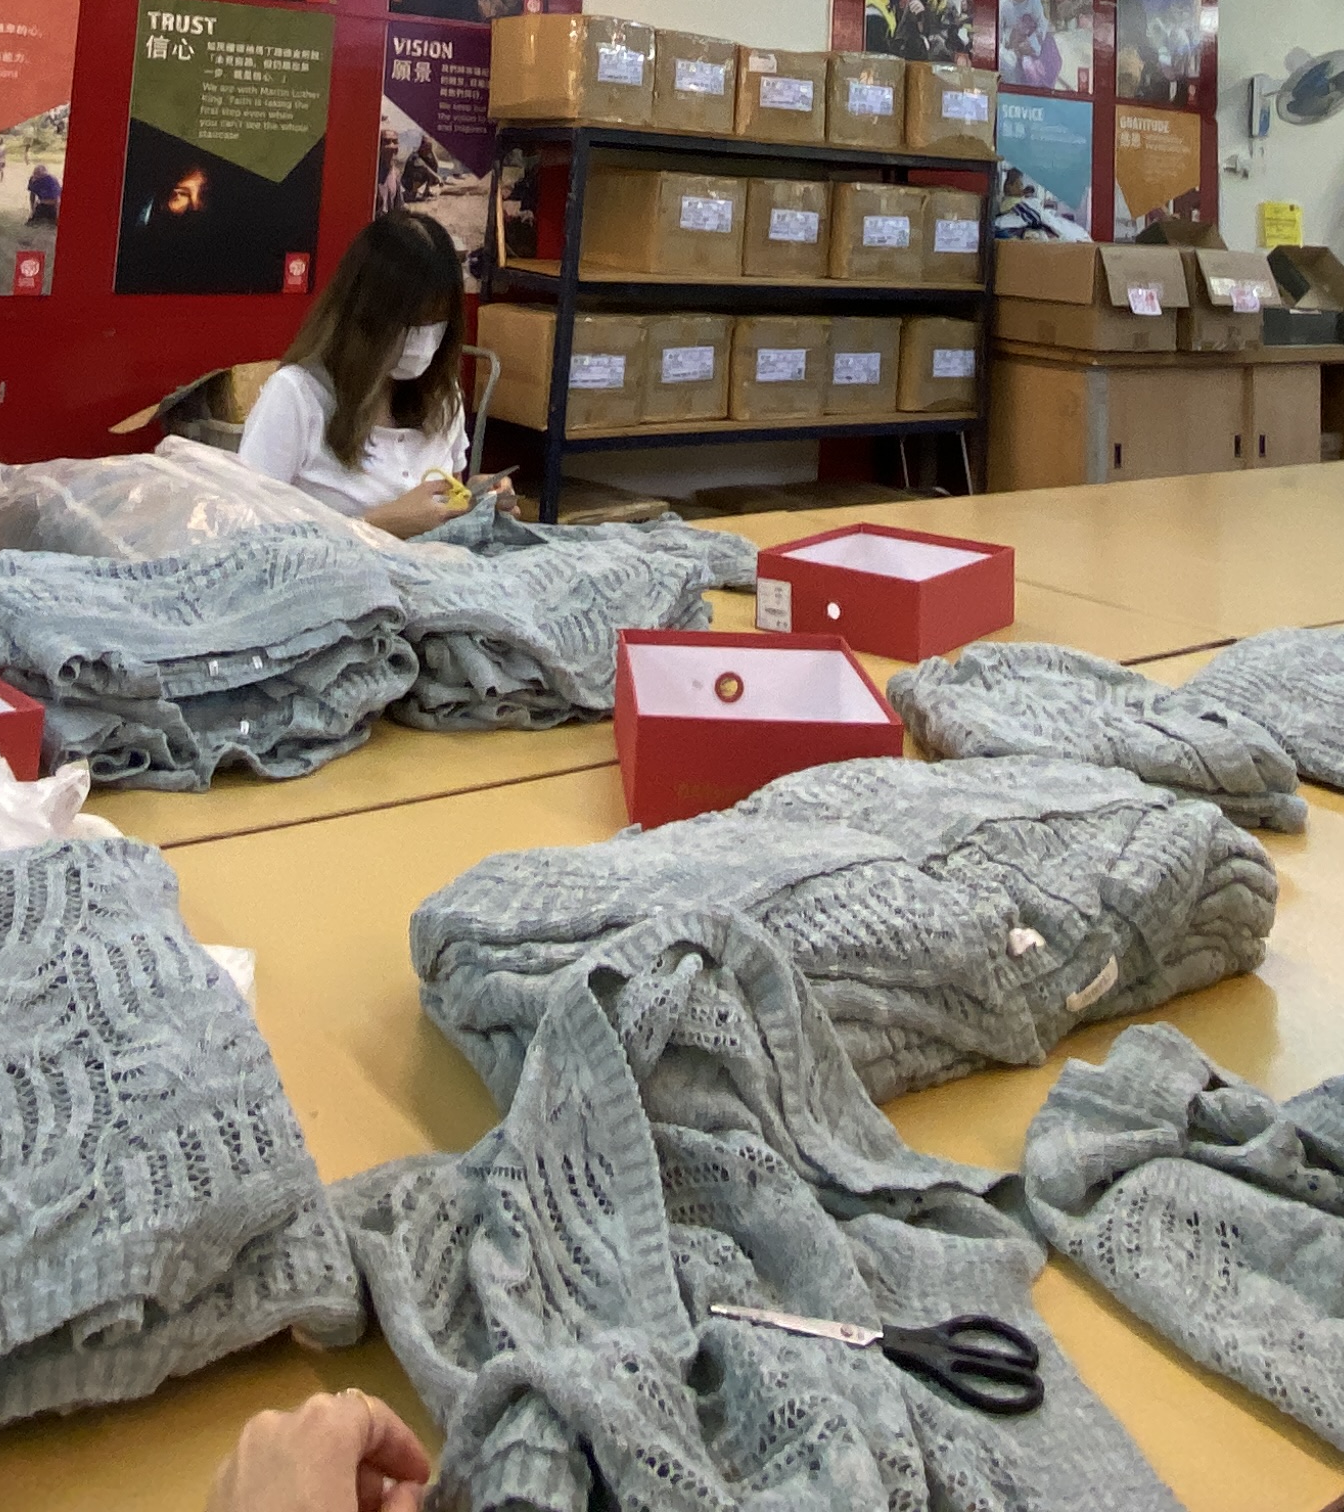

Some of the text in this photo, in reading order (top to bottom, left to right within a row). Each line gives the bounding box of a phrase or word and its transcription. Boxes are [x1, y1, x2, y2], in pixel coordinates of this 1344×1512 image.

[147, 11, 217, 35] TRUST
[145, 34, 195, 61] 信心
[393, 37, 453, 60] VISION
